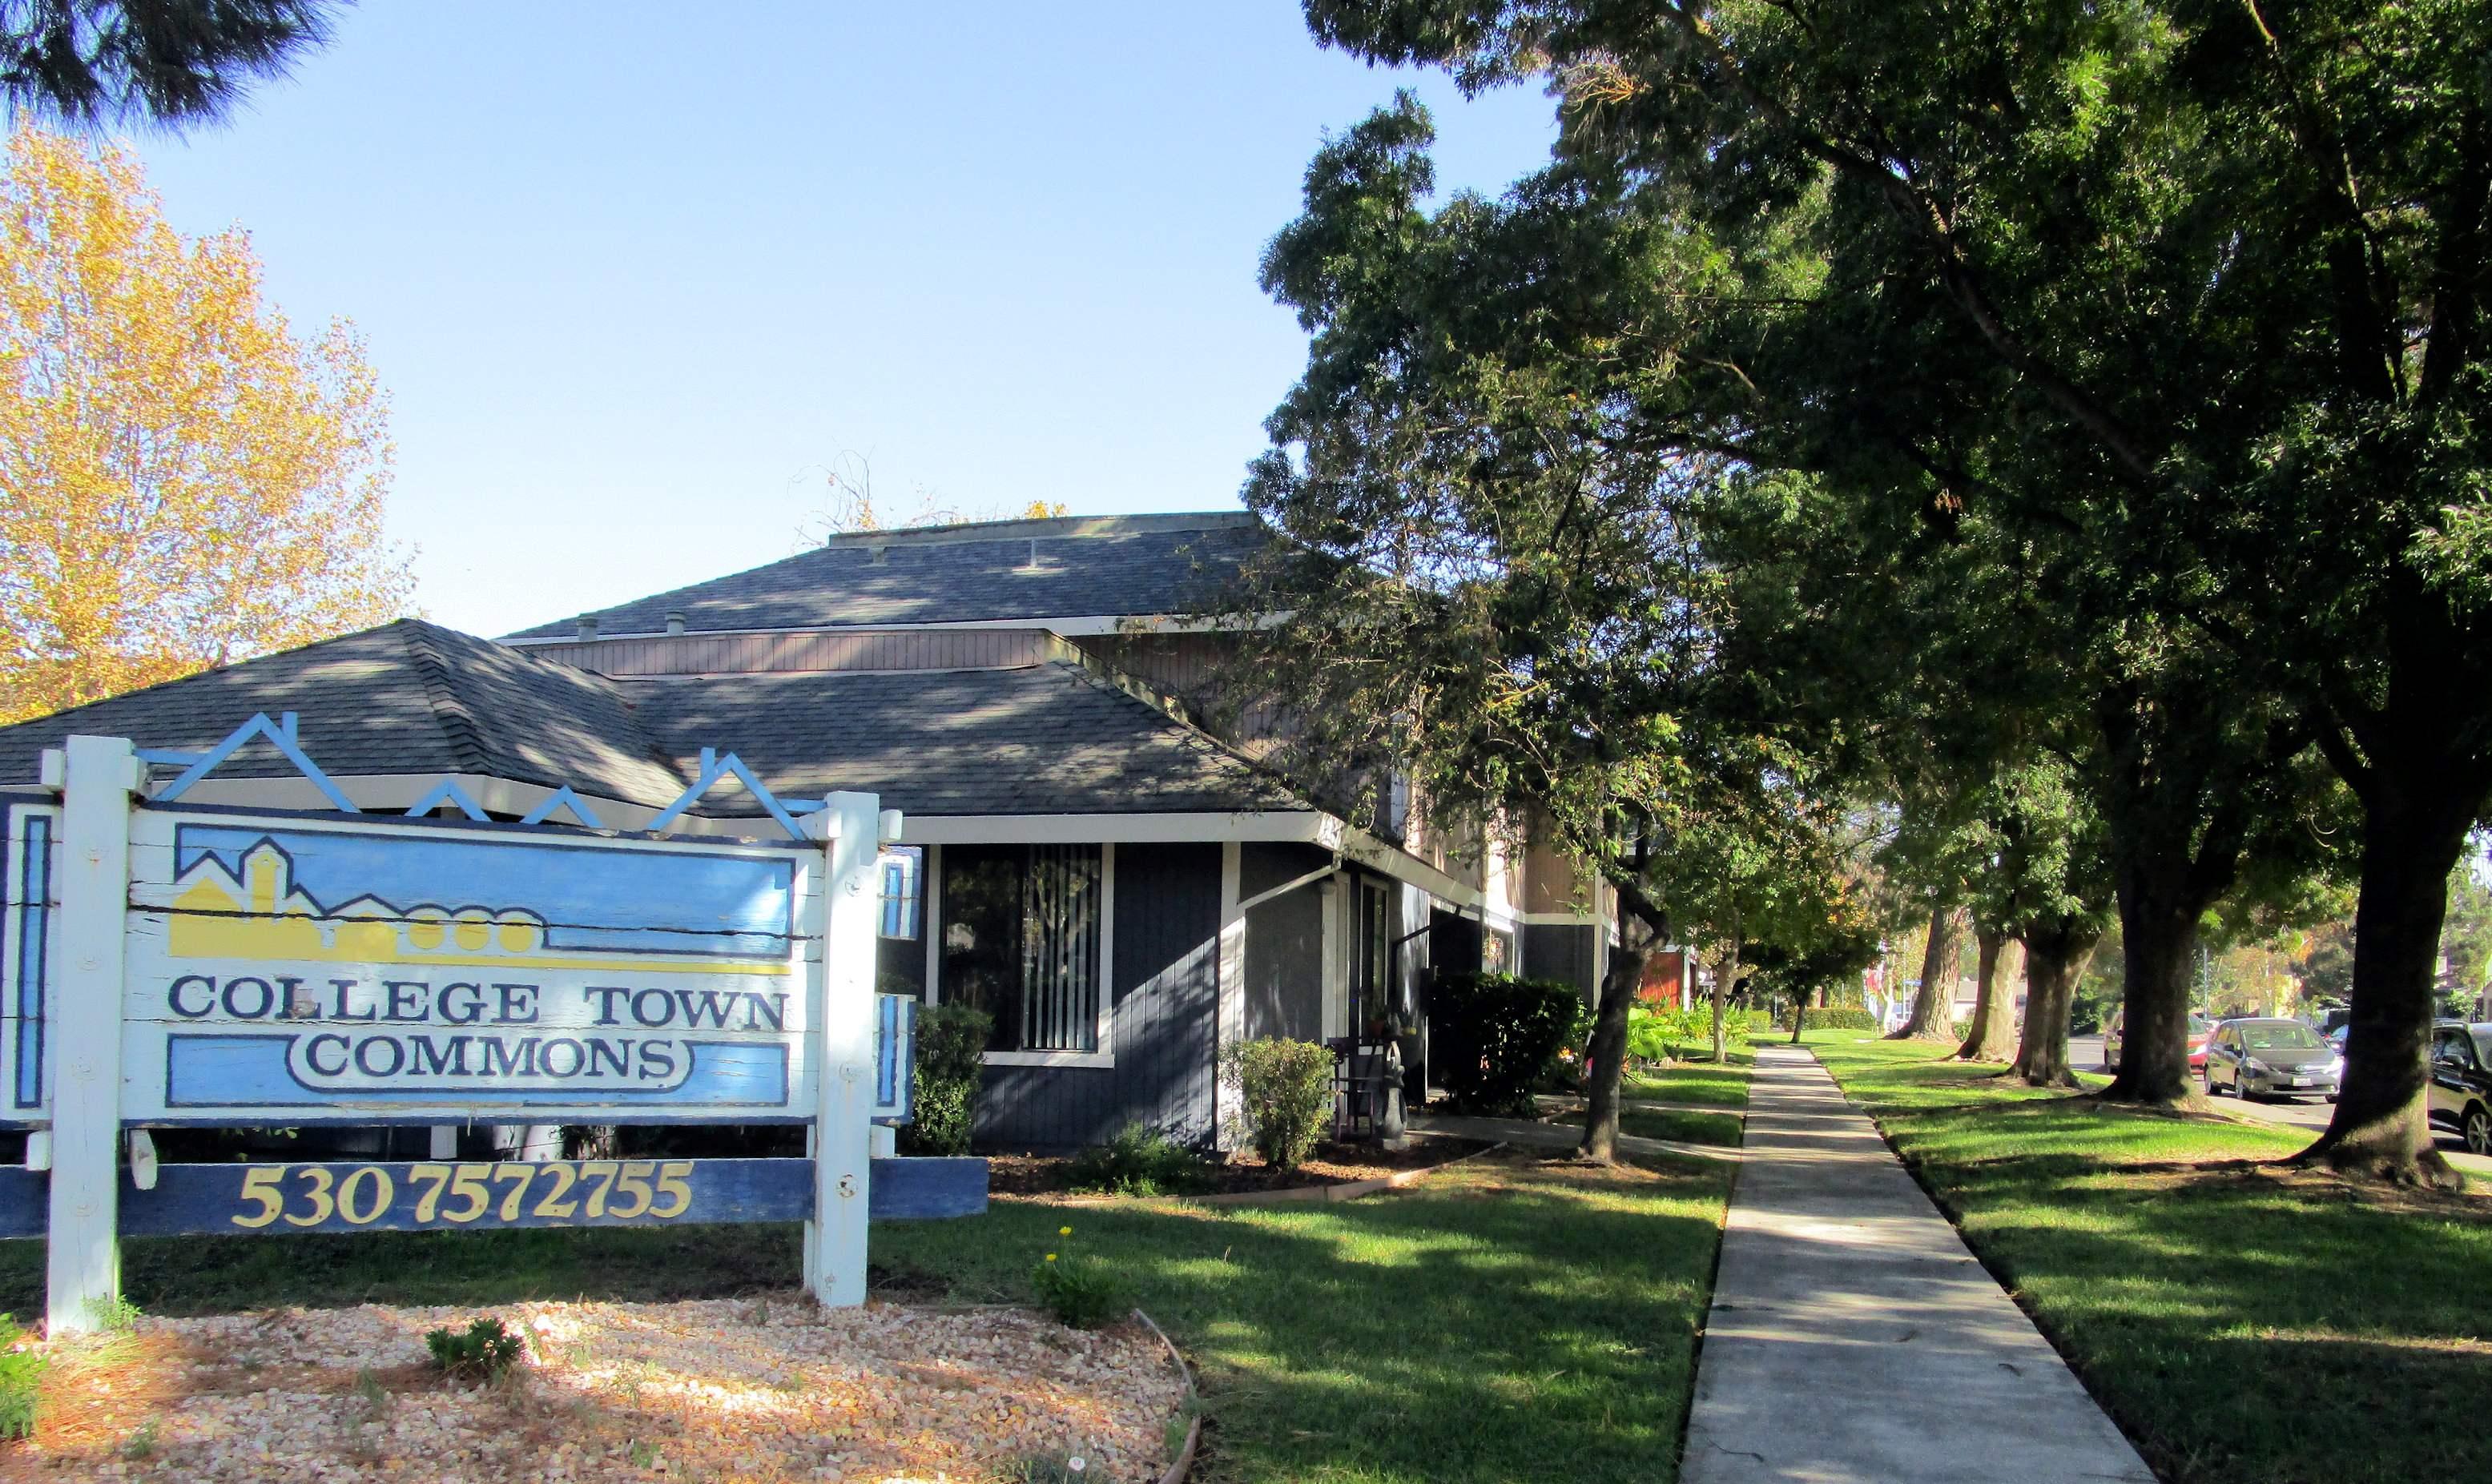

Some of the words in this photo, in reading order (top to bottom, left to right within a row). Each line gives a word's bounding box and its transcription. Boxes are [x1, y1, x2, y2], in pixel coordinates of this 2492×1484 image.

[167, 975, 540, 1024] COLLEGE
[583, 986, 790, 1032] TOWN
[306, 1033, 675, 1080] COMMONS
[231, 1165, 393, 1229] 530
[408, 1160, 694, 1223] 7572755
